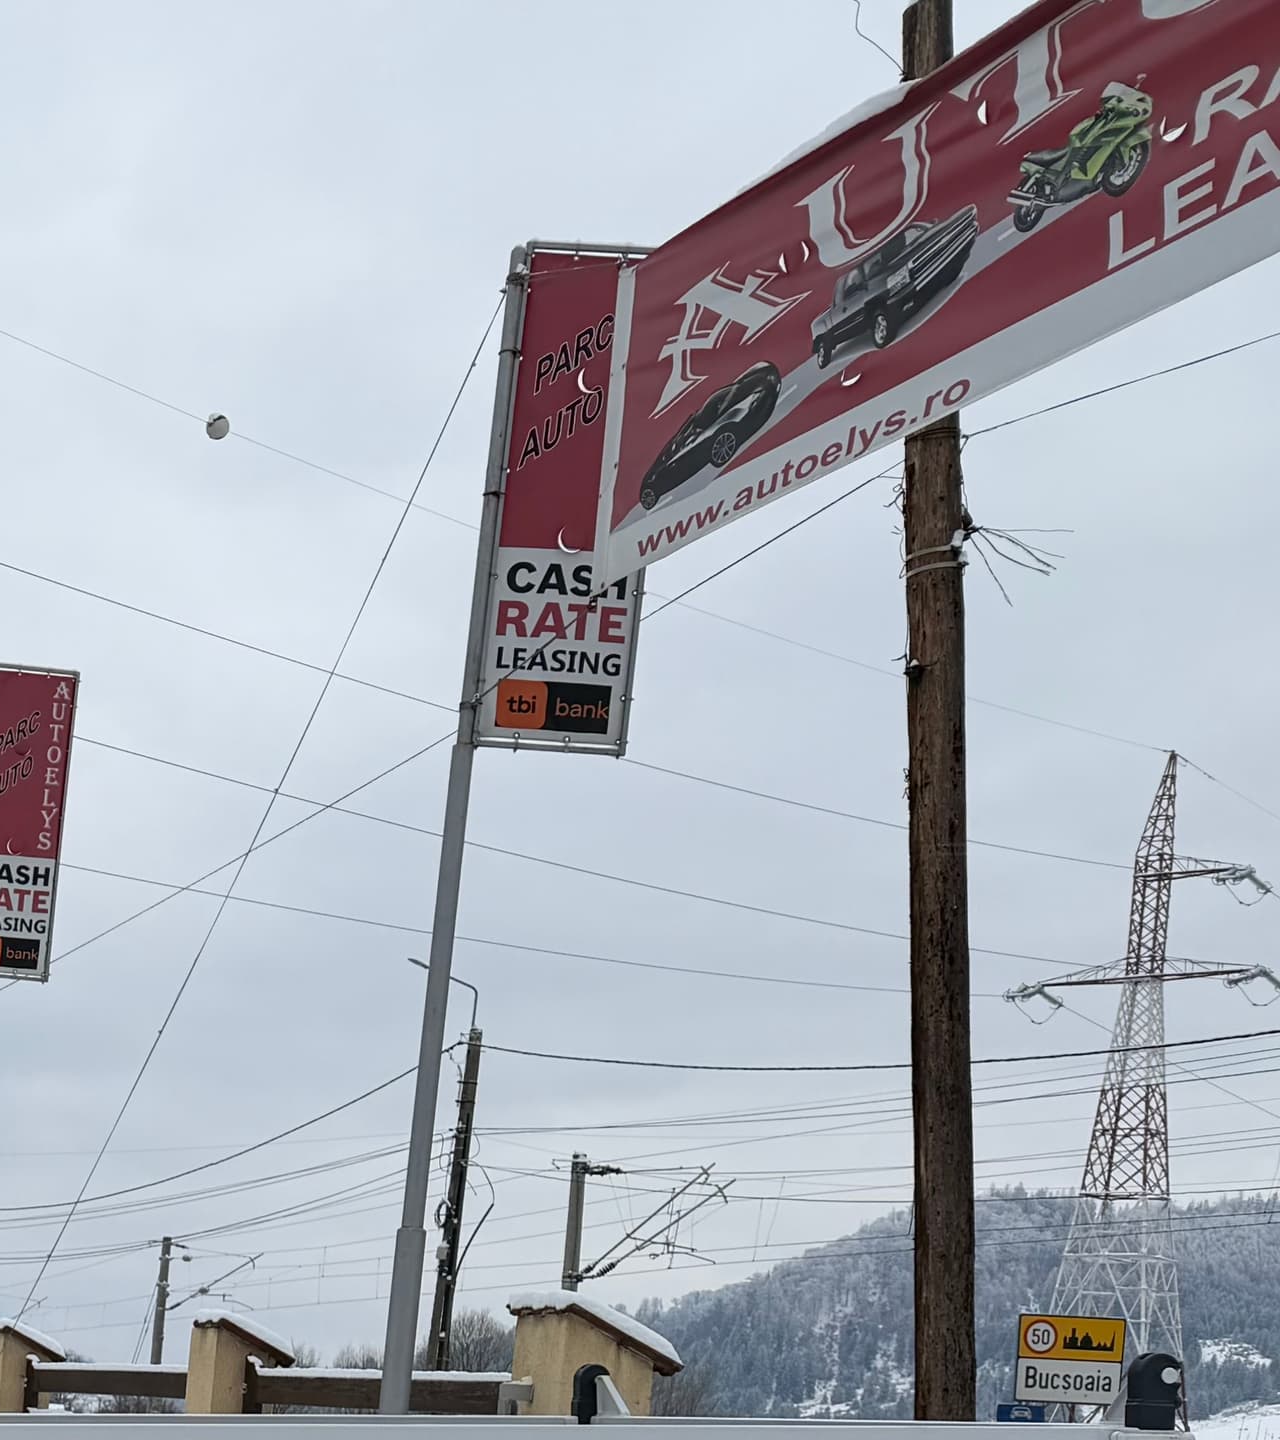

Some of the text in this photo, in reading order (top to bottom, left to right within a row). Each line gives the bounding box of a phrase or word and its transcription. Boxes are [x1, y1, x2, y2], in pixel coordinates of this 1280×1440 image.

[649, 0, 1222, 419] AUT
[534, 313, 615, 396] PARC
[517, 385, 604, 471] AUTO
[637, 379, 971, 557] www.autoelys.ro
[495, 599, 628, 644] RATE
[495, 646, 622, 676] LEASING
[506, 695, 609, 719] tbi bank
[37, 681, 72, 850] AUTOELYS
[6, 947, 39, 960] bank
[1031, 1328, 1051, 1346] 50
